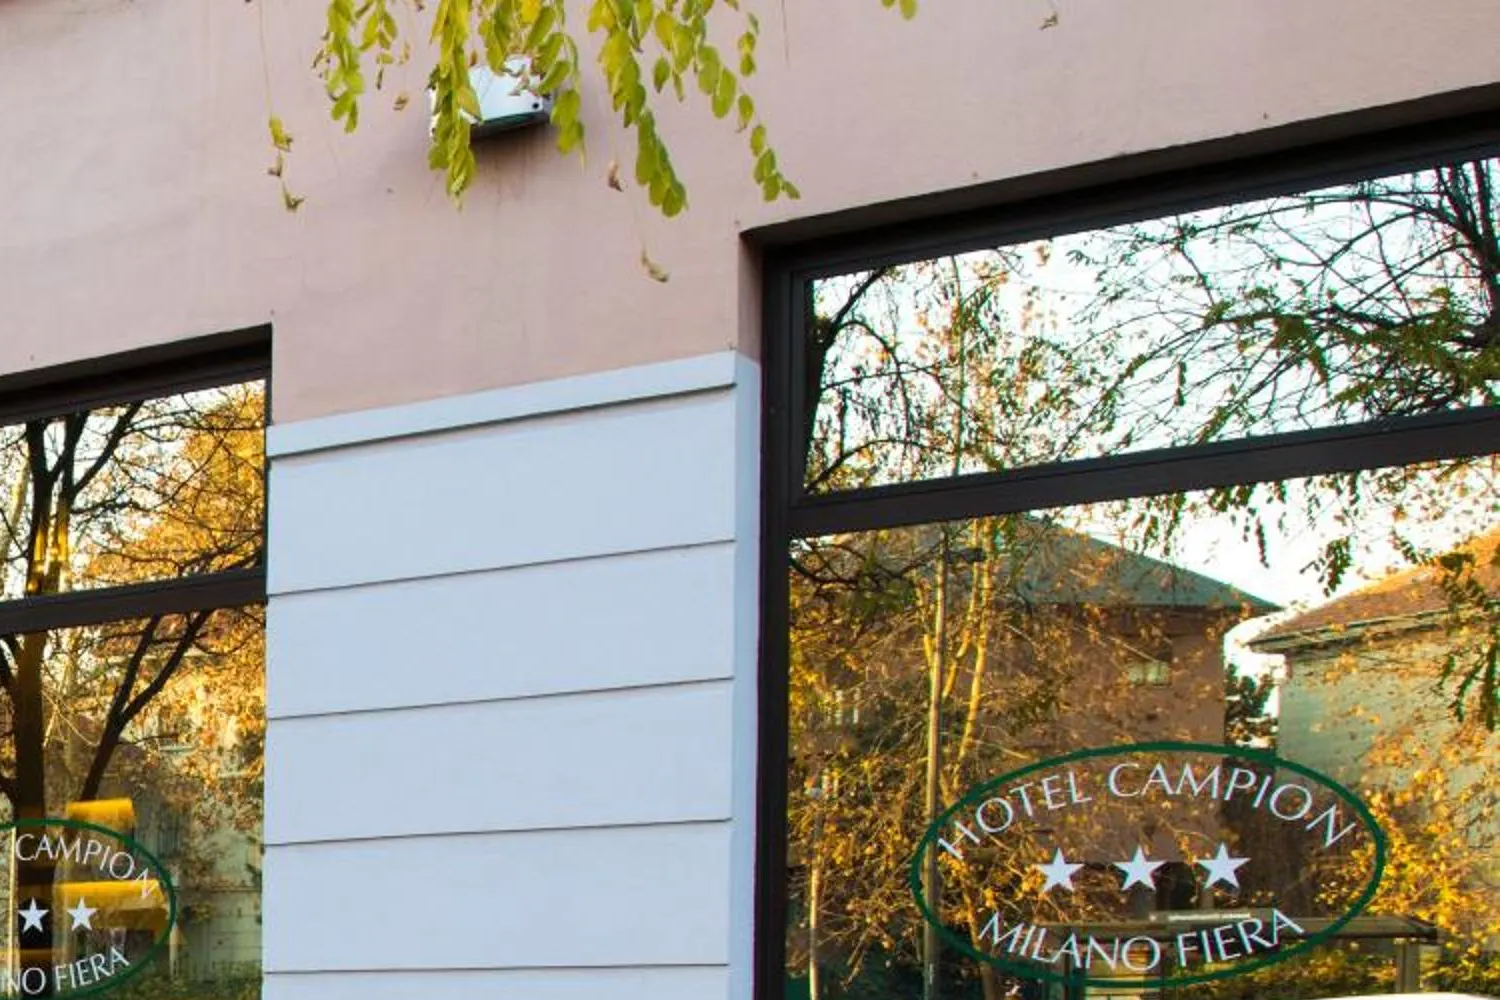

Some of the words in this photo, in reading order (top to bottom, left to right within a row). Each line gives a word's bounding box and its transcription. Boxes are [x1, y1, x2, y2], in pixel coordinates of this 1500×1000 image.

[937, 770, 1092, 861] HOTEL
[1107, 762, 1357, 849] CAMPION
[16, 833, 160, 900] CAMPION
[55, 946, 131, 992] FIERA
[977, 911, 1160, 971] MILANO
[1176, 908, 1306, 968] FIERA
